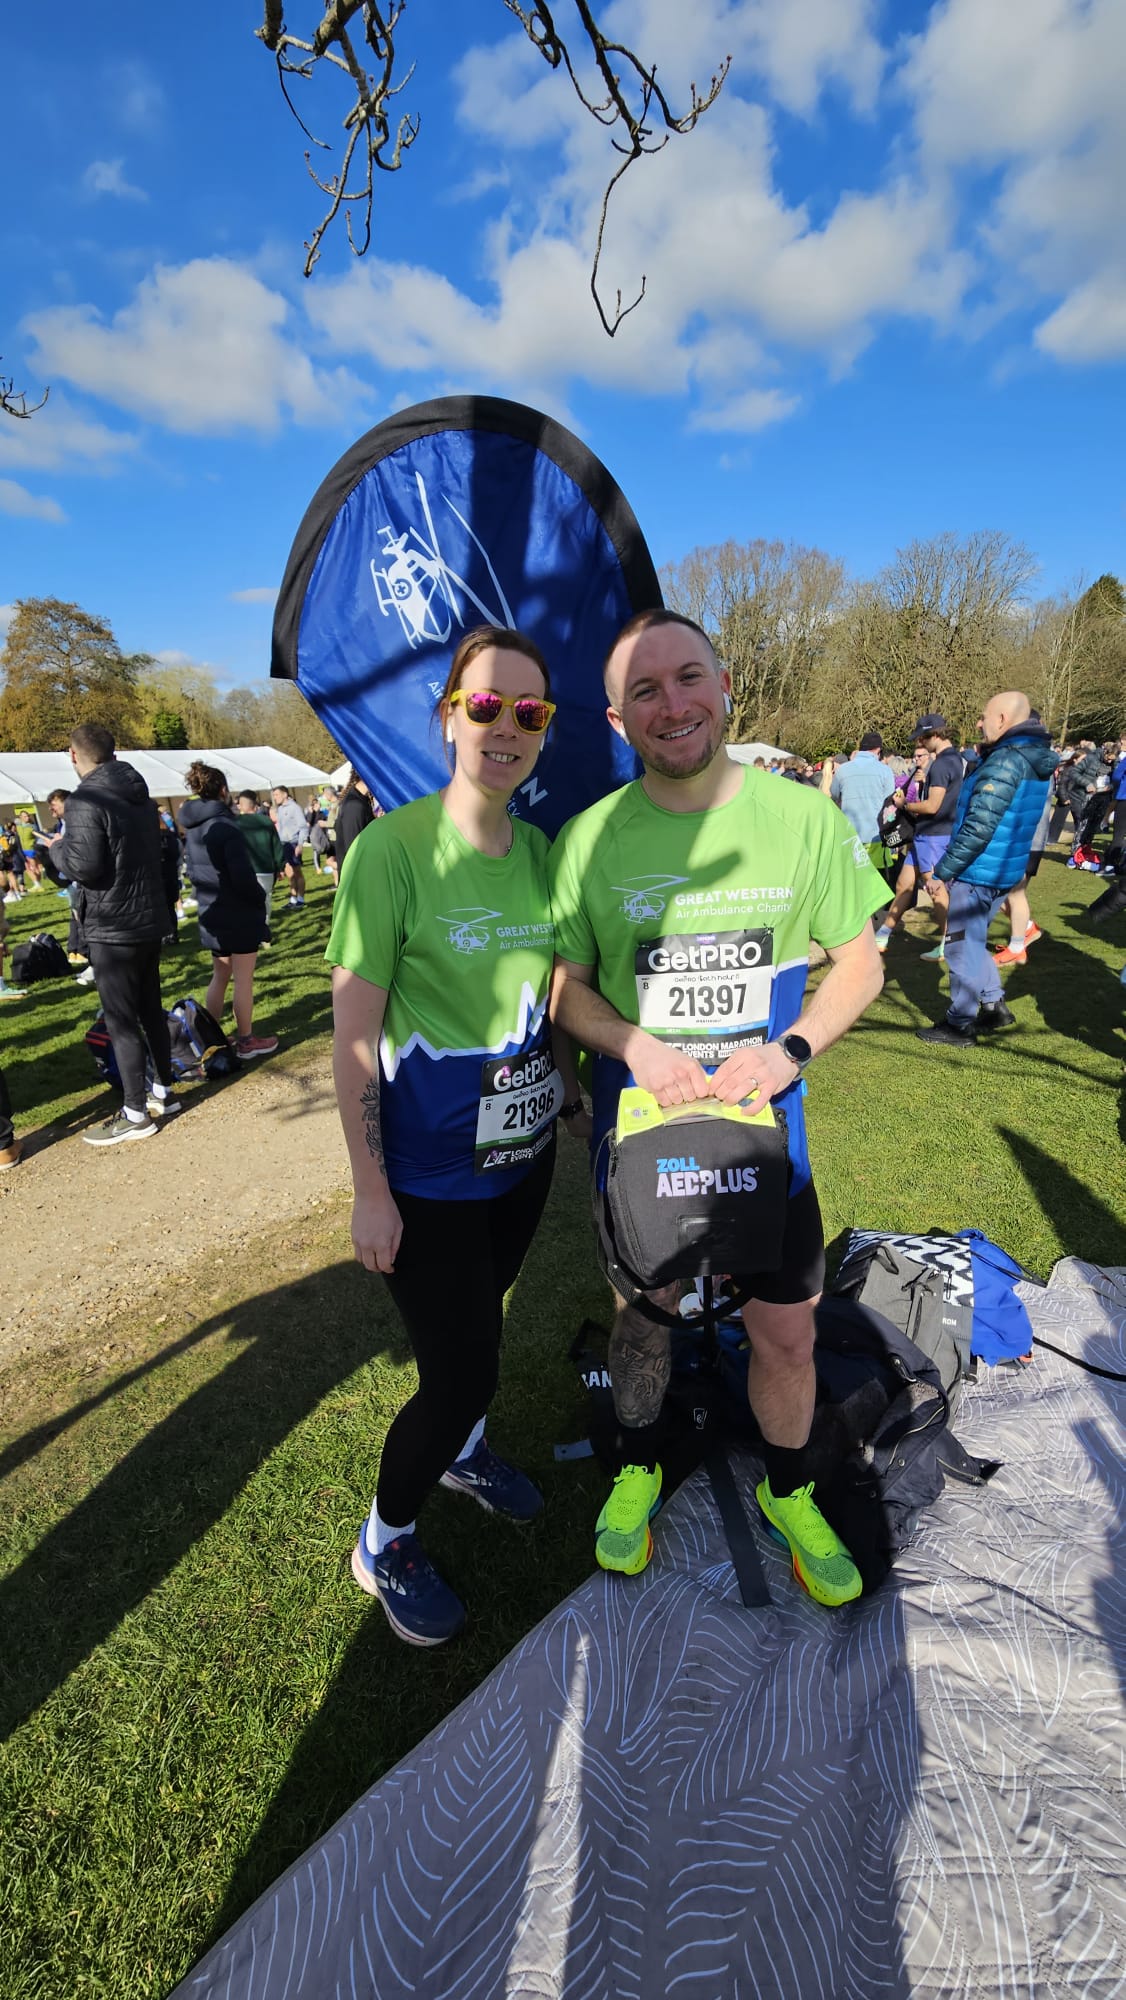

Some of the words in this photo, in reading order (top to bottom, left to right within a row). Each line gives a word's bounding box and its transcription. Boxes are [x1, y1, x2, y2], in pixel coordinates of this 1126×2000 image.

[674, 890, 722, 906] GREAT
[725, 887, 794, 901] WESTERN
[676, 910, 689, 919] Air
[693, 904, 753, 916] Ambulance
[496, 925, 529, 938] GREAT
[648, 941, 761, 972] GetPRO
[669, 983, 747, 1016] 21397
[682, 1042, 719, 1052] LONDON
[720, 1035, 763, 1051] MARATHON
[503, 1087, 555, 1131] 21396
[656, 1156, 700, 1173] ZOLL
